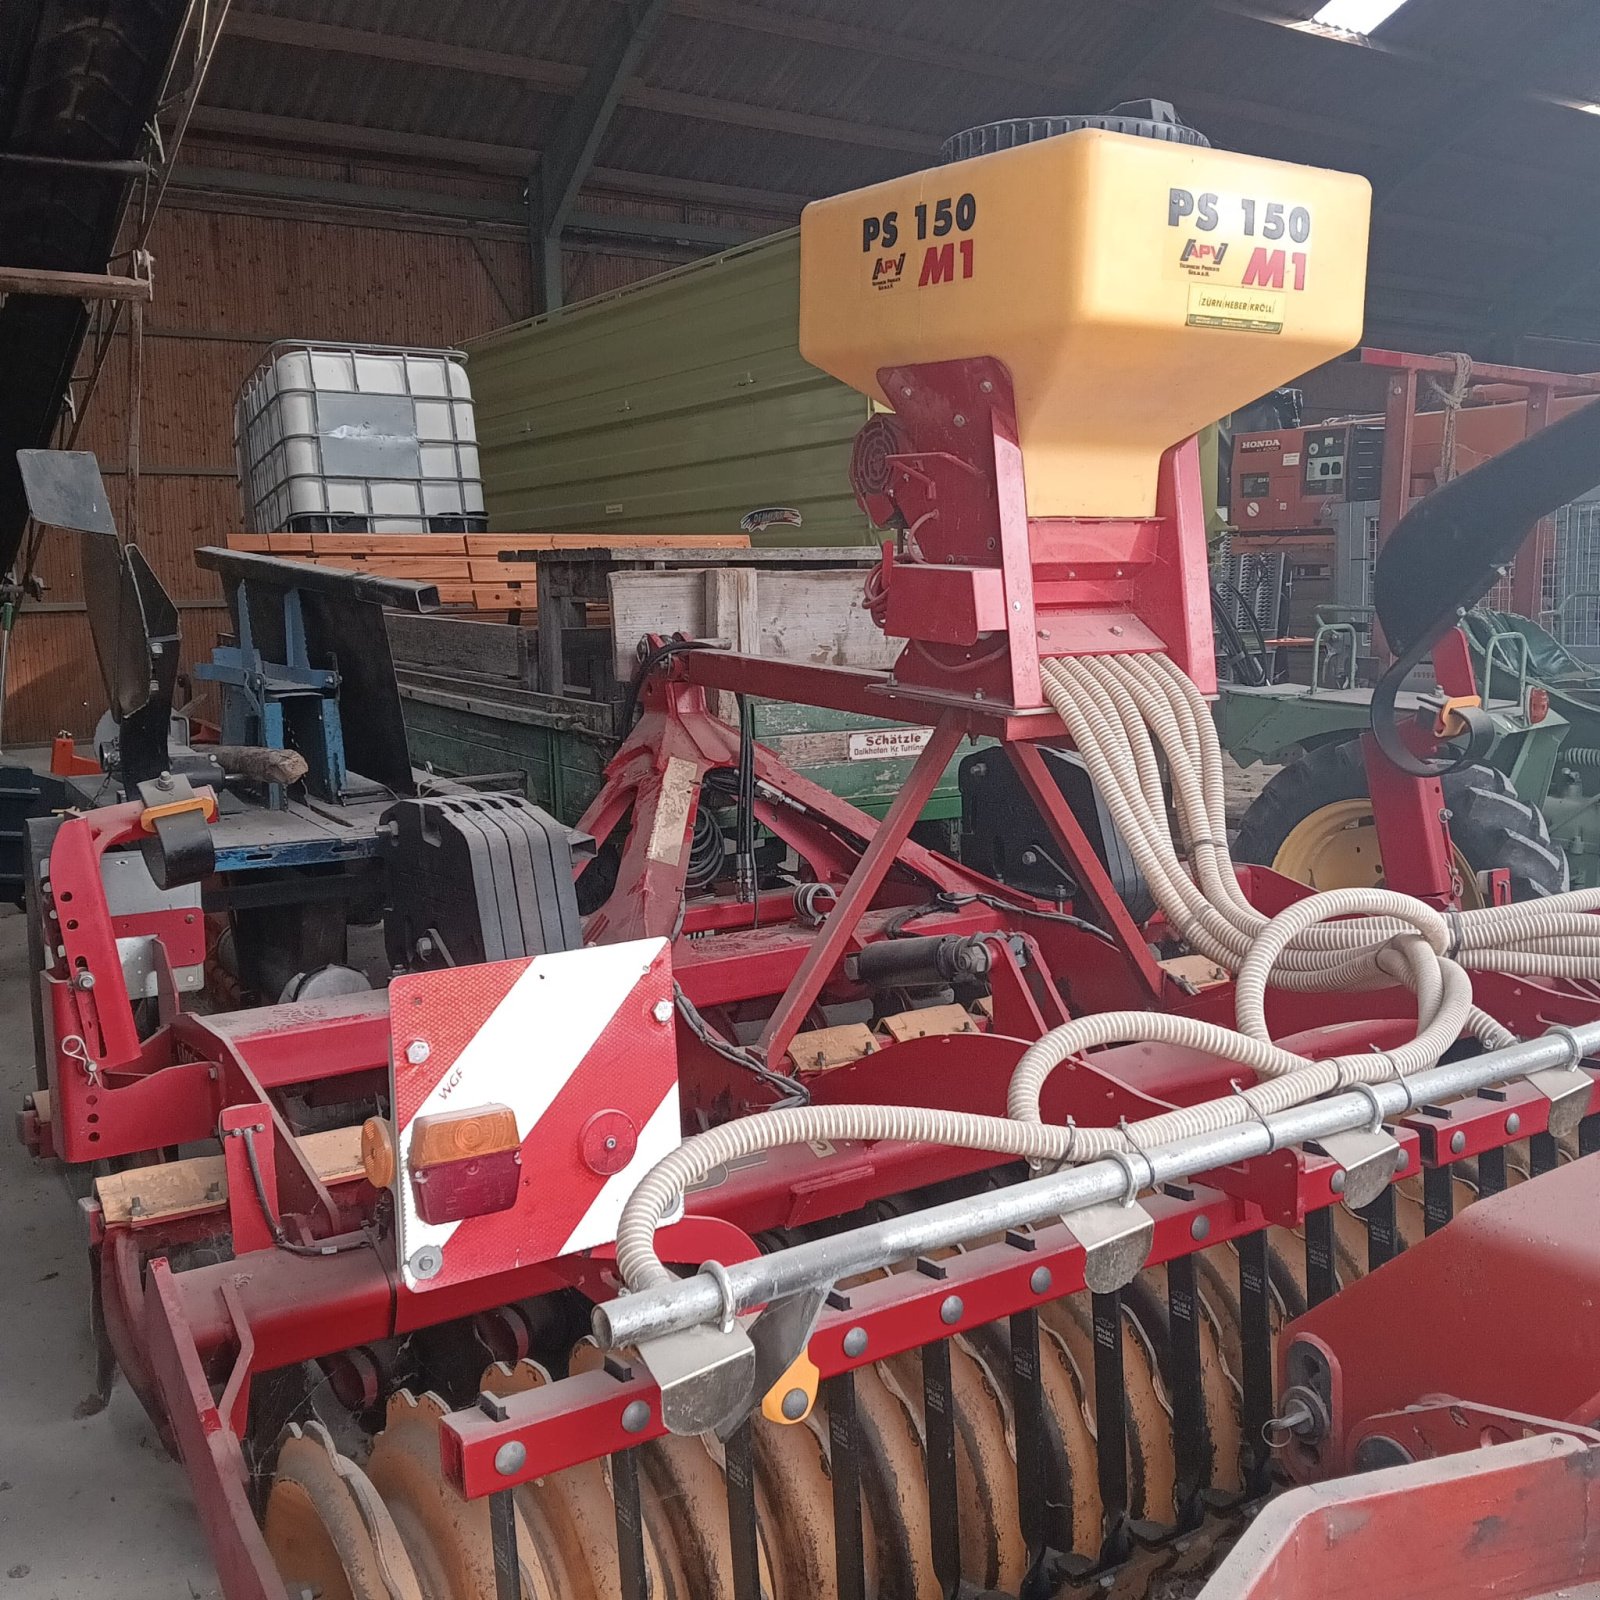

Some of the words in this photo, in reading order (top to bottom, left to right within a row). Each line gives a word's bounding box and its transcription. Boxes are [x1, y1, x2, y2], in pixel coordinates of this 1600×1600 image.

[863, 211, 898, 253] PS
[914, 193, 976, 240] 150
[1168, 188, 1219, 232] PS
[1241, 198, 1310, 243] 150
[918, 239, 974, 287] M1
[1241, 247, 1307, 291] M1
[1225, 300, 1248, 310] HEBER
[1242, 440, 1280, 449] HONDA
[866, 733, 921, 747] Schätzle
